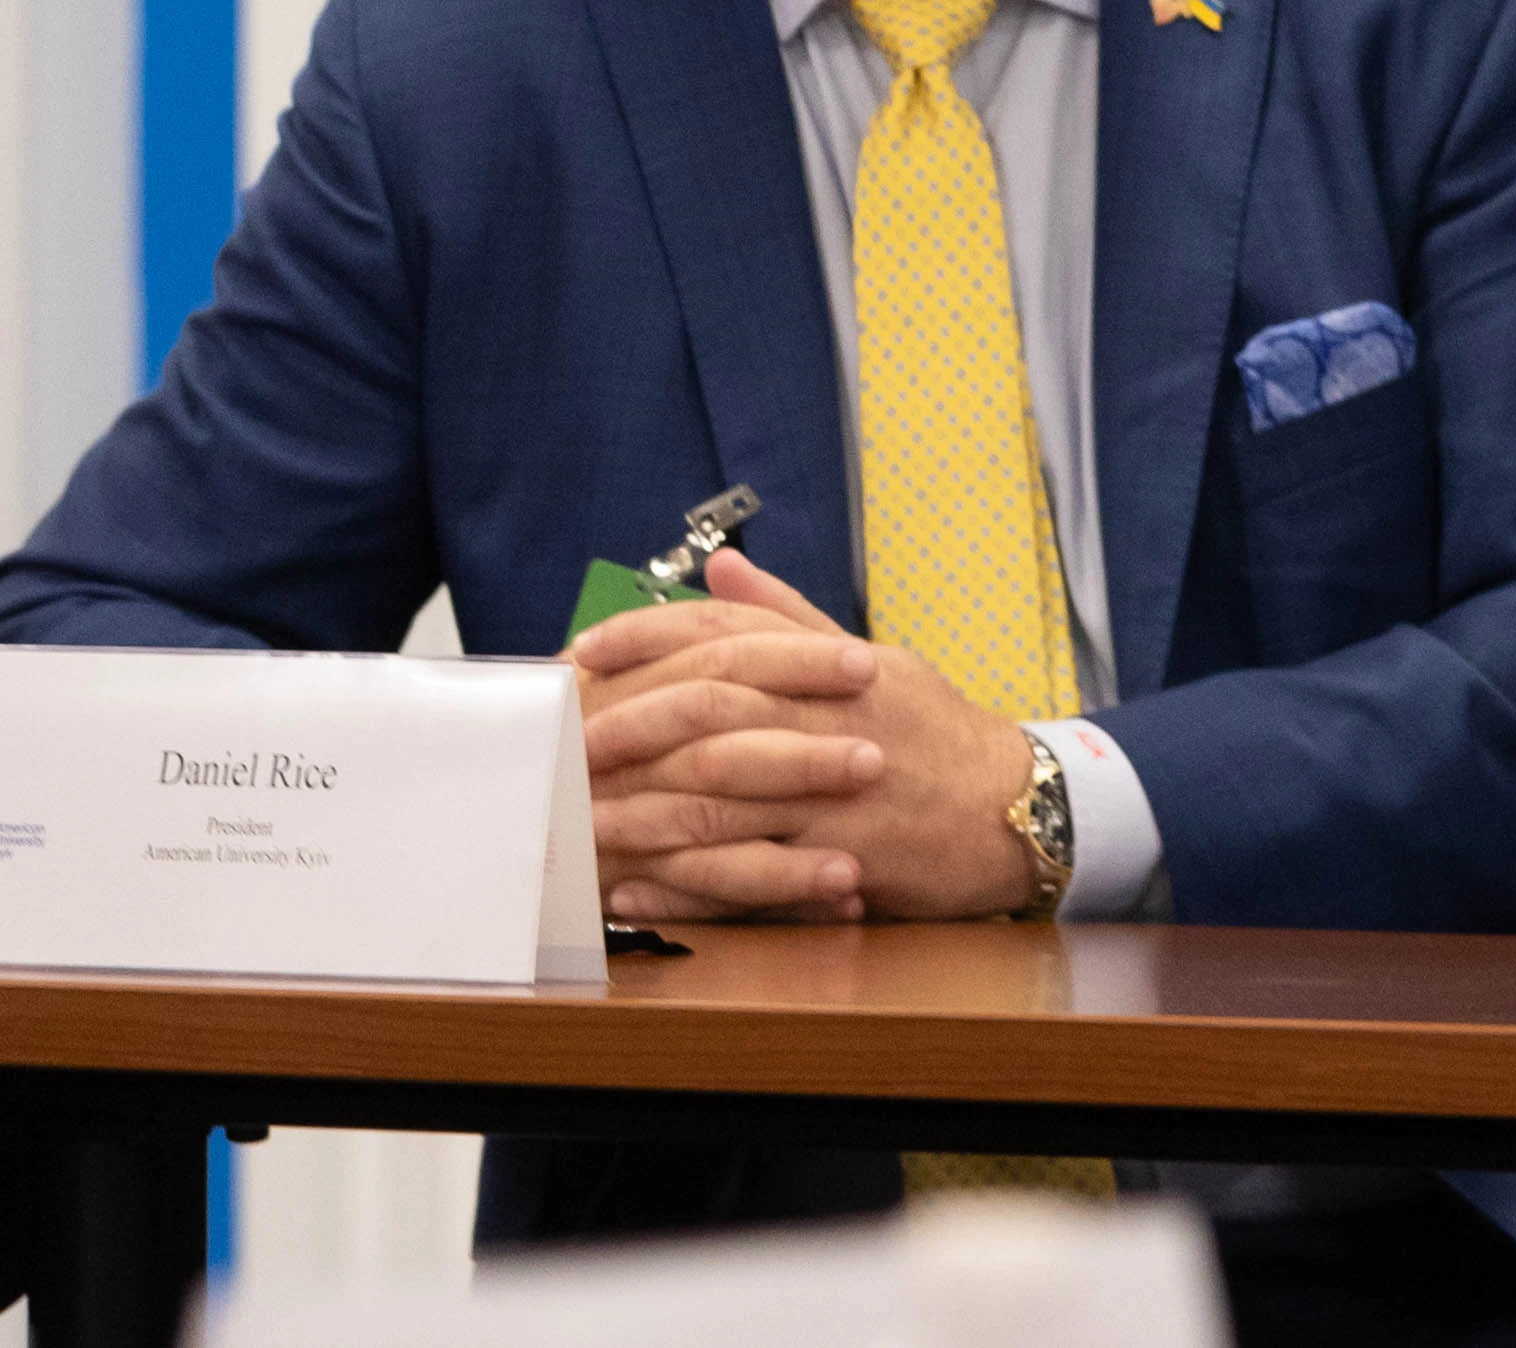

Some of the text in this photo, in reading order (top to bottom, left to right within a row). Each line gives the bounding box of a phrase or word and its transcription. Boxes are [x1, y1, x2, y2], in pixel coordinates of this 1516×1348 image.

[158, 749, 338, 790] Daniel Rice
[205, 816, 274, 837] President
[143, 843, 212, 863] American
[216, 844, 288, 869] University
